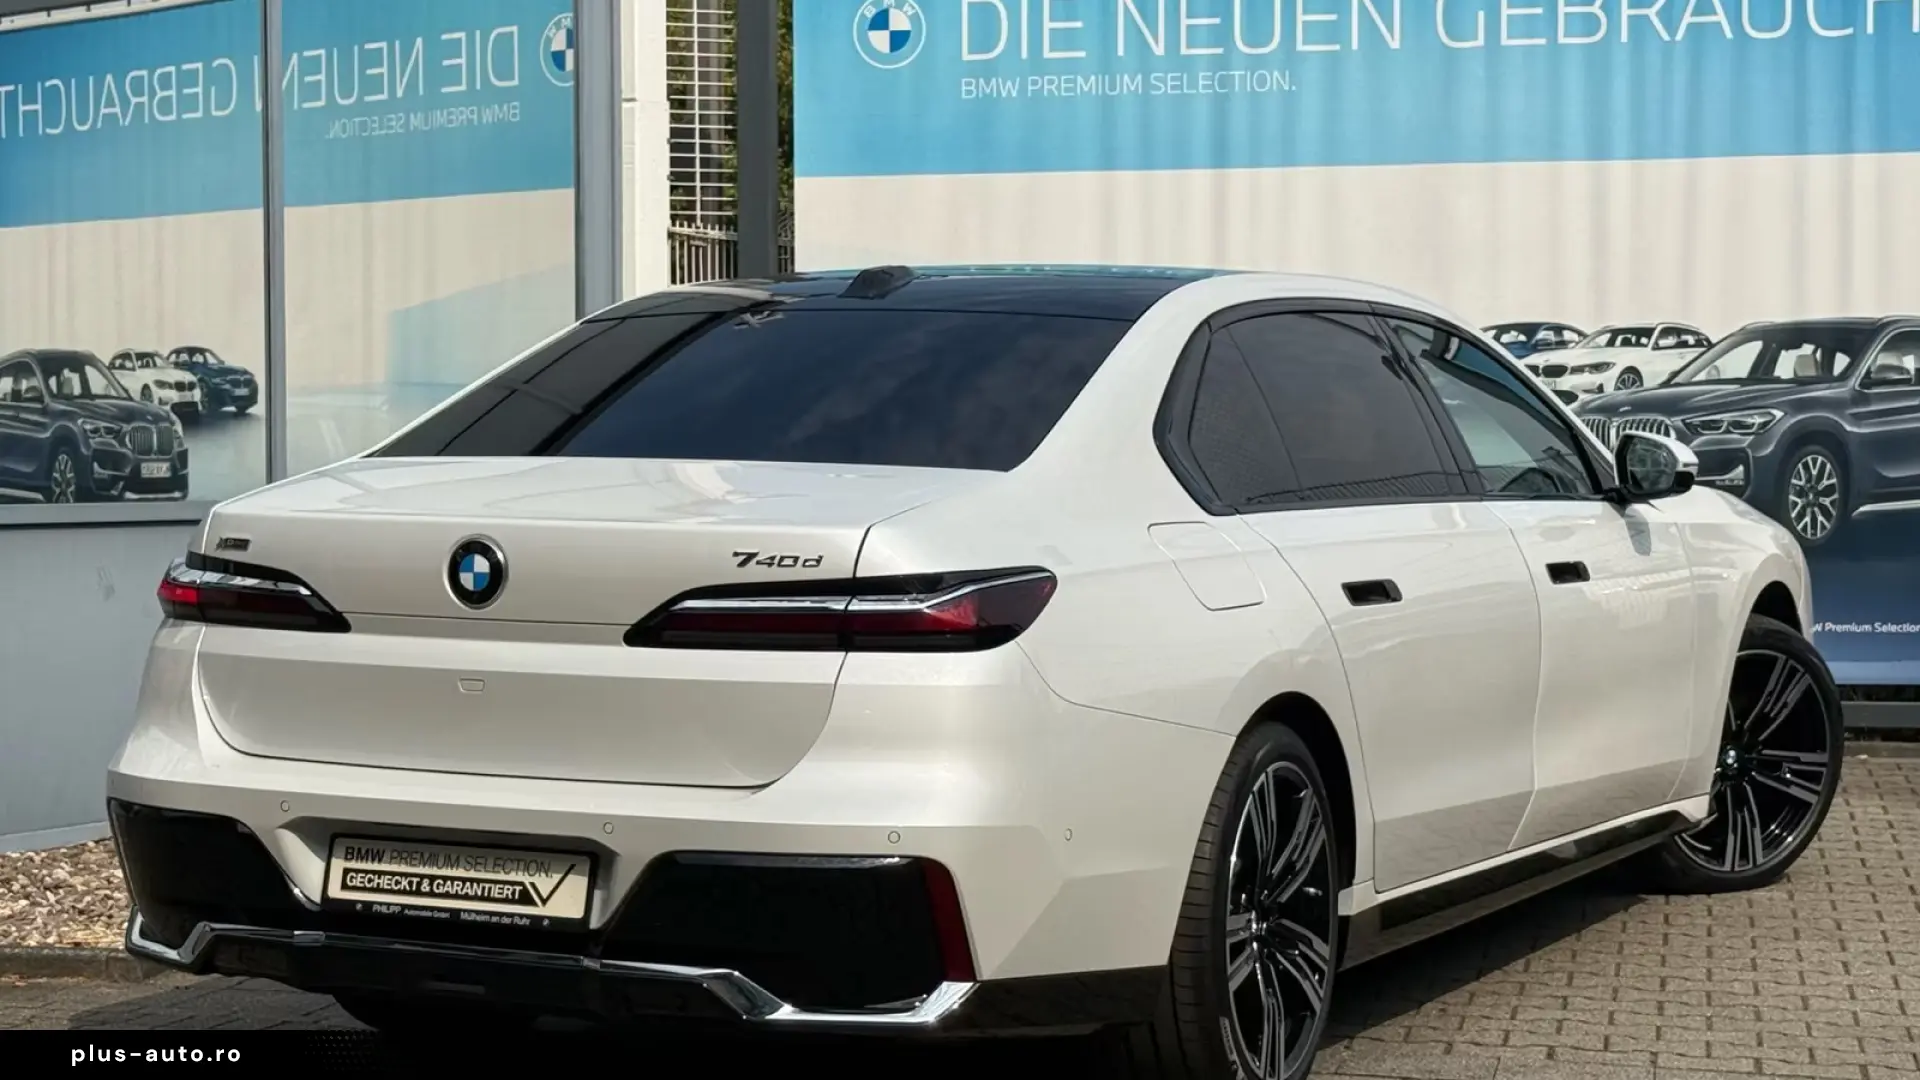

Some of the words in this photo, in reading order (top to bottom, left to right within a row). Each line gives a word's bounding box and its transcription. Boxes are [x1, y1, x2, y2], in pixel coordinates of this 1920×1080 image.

[960, 0, 1087, 61] DIE
[1115, 0, 1401, 57] NEUEN
[960, 77, 1020, 99] BMW
[1026, 73, 1143, 98] PREMIUM
[1149, 70, 1297, 95] SELECTION.
[731, 550, 824, 569] 740d
[1824, 622, 1872, 633] Premium
[343, 846, 386, 864] BMW
[389, 849, 460, 871] PREMIUM
[463, 855, 553, 879] SELECTION.
[346, 871, 421, 891] GECHECKT
[420, 878, 431, 893] &
[432, 879, 523, 900] GARANTIERT
